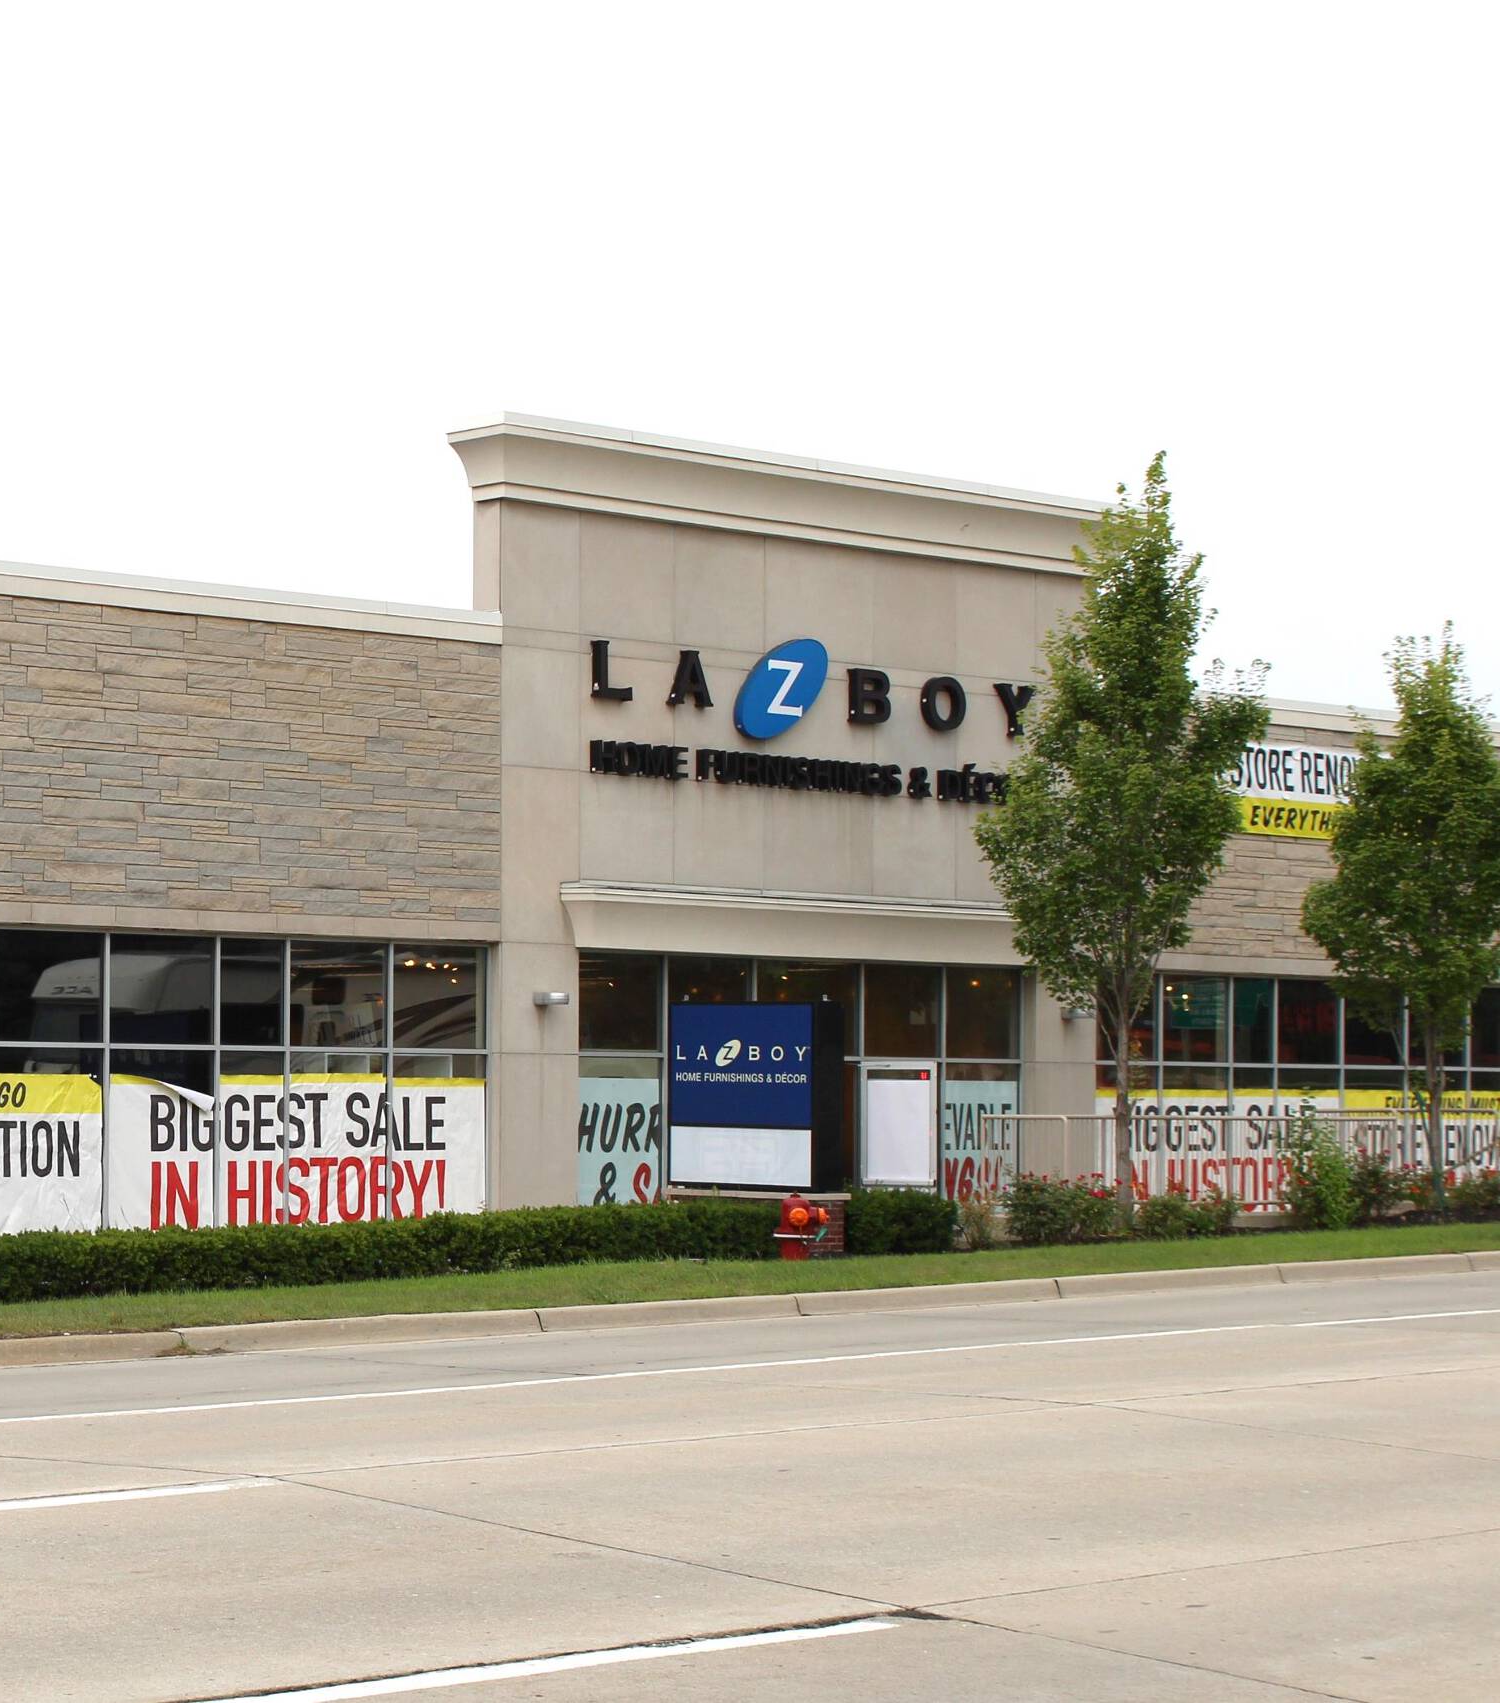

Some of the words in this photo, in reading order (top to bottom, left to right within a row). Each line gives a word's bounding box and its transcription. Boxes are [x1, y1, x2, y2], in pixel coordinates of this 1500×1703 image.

[589, 739, 689, 781] HOME
[696, 748, 902, 798] FURNISHINGS
[907, 766, 932, 799] &
[676, 1072, 701, 1082] HOME
[704, 1073, 764, 1083] FURNISHINGS
[766, 1074, 772, 1083] &
[775, 1071, 807, 1083] DÉCOR
[150, 1093, 328, 1152] BIGGEST
[345, 1092, 446, 1151] SALE
[578, 1103, 660, 1153] HURR
[151, 1161, 199, 1231] IN
[227, 1156, 447, 1226] HISTORY!
[593, 1162, 616, 1206] &
